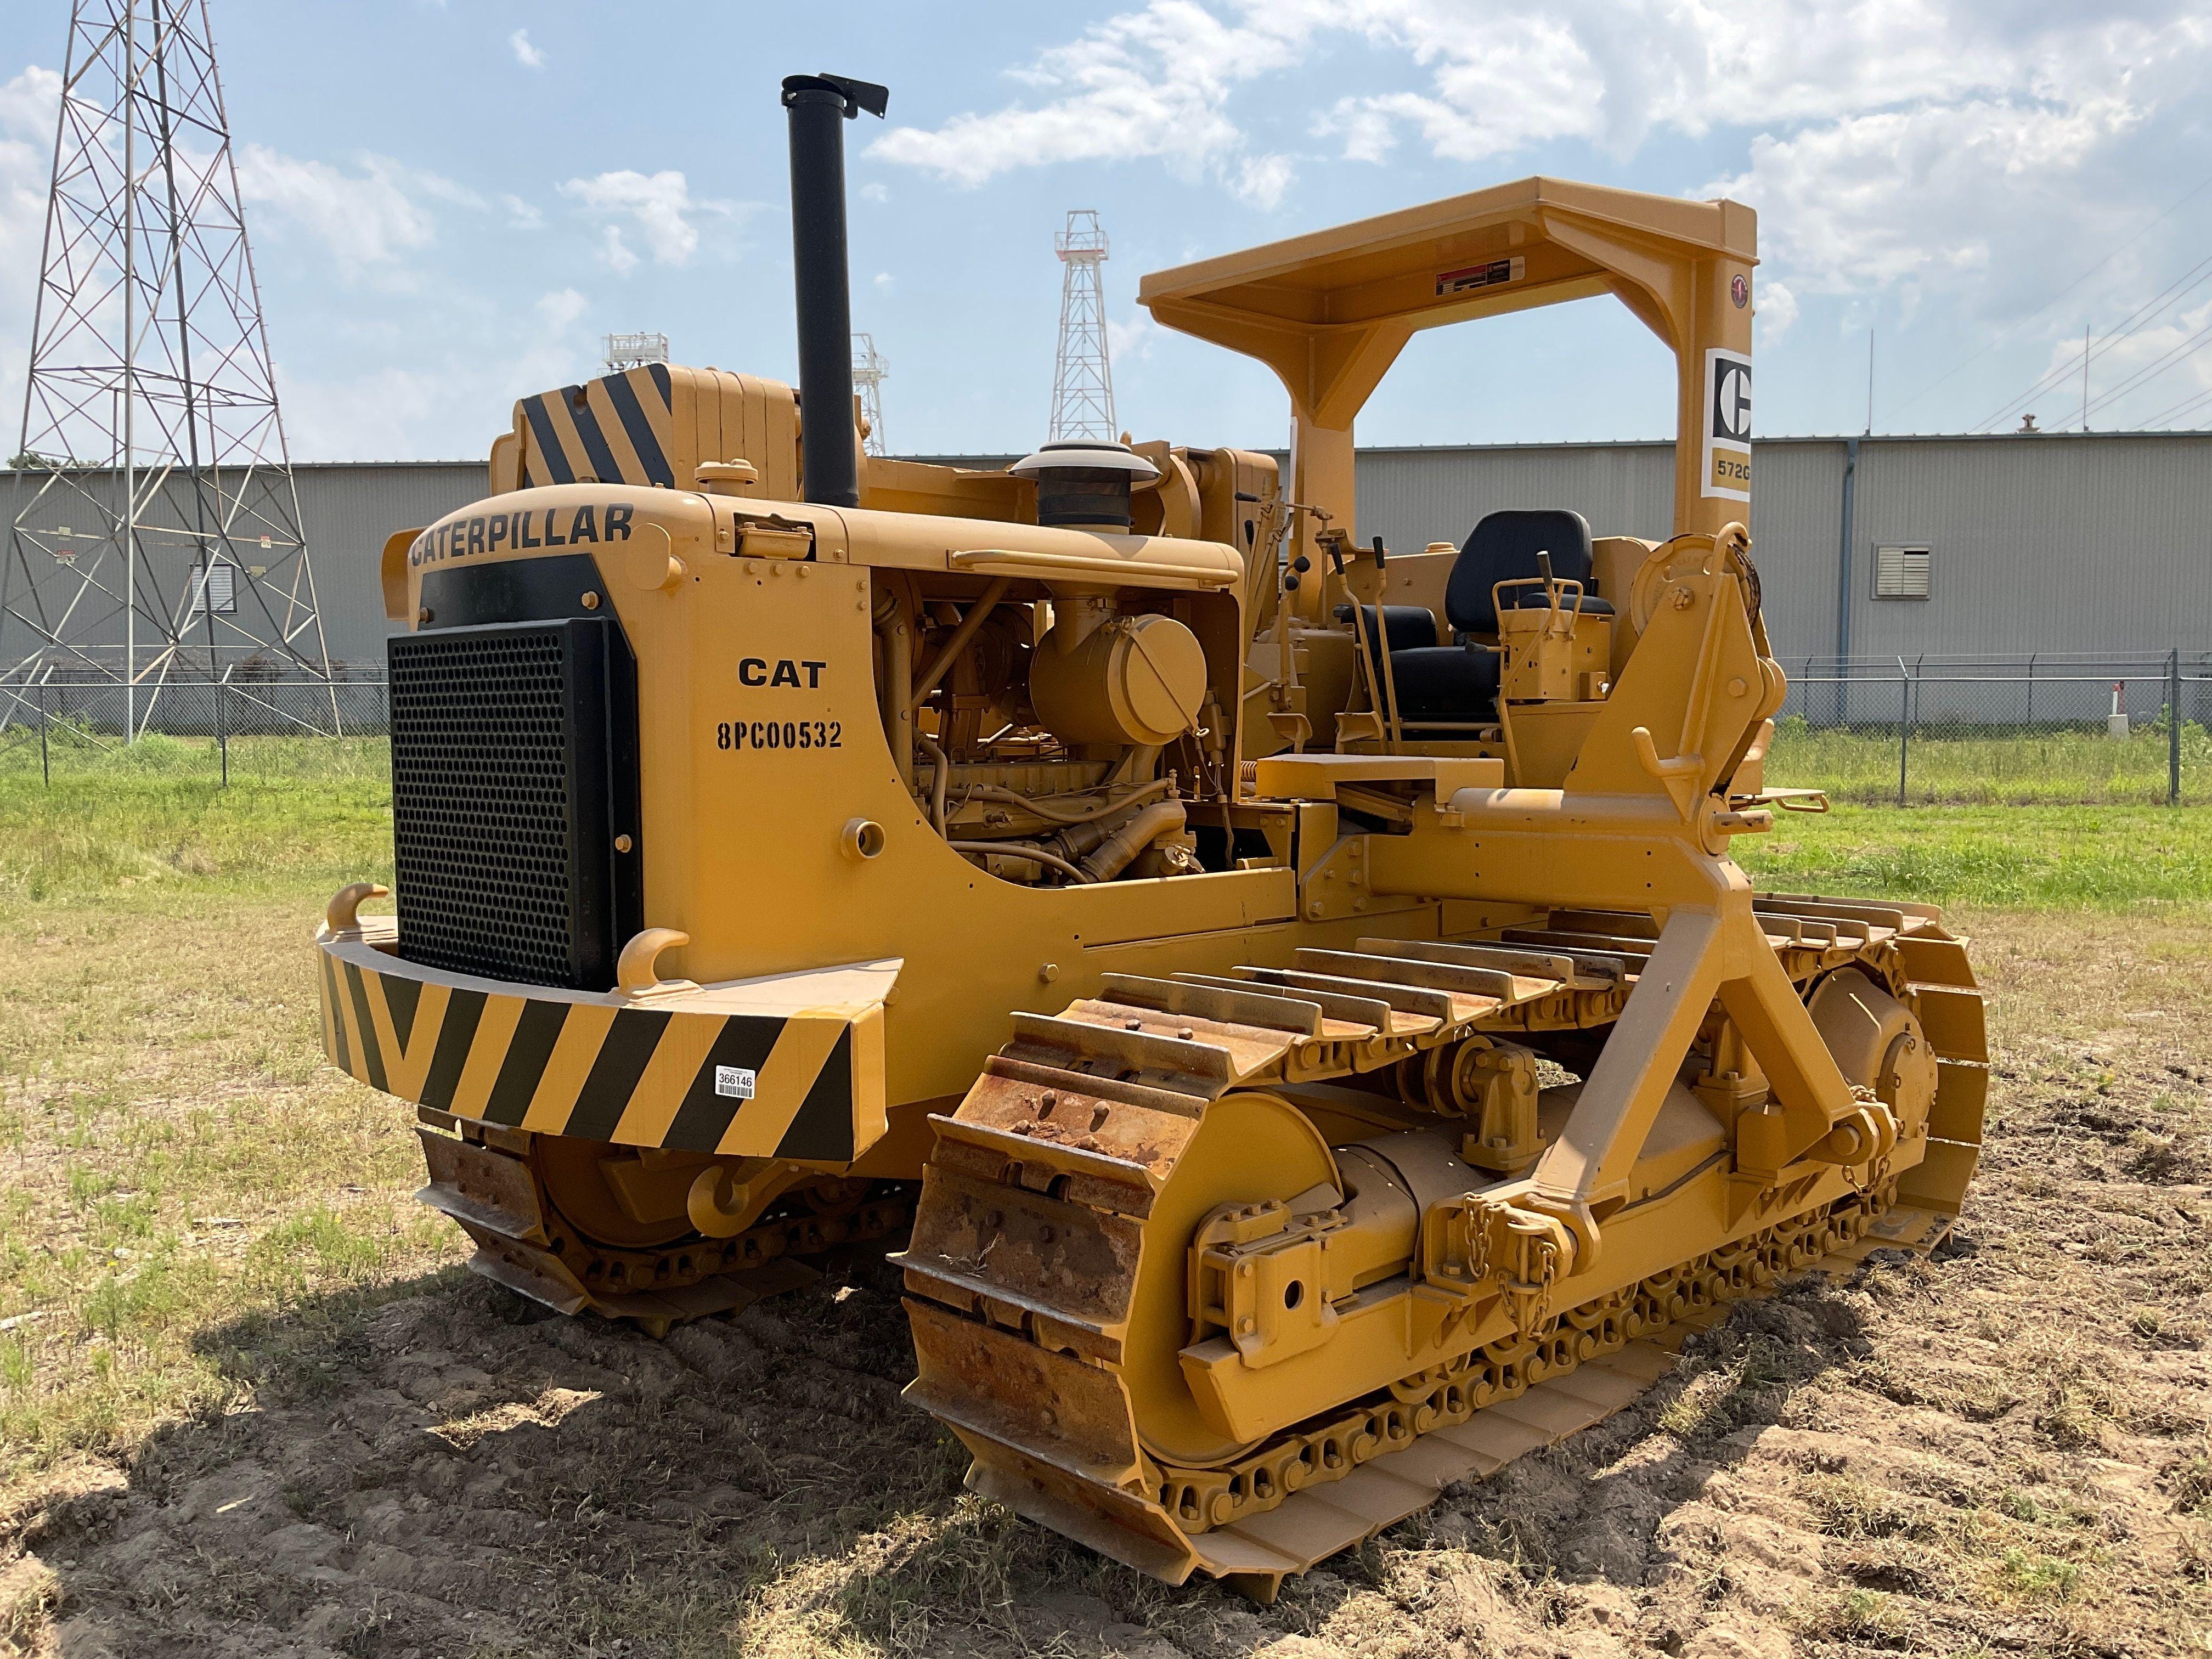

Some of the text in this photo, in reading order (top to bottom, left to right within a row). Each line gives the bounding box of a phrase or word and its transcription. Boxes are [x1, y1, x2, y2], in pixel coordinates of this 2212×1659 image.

[1718, 460, 1750, 480] 572G
[411, 503, 634, 566] CATERPILLAR
[739, 658, 826, 689] CAT
[718, 721, 842, 750] 8PC00532
[719, 1073, 752, 1087] 366146
